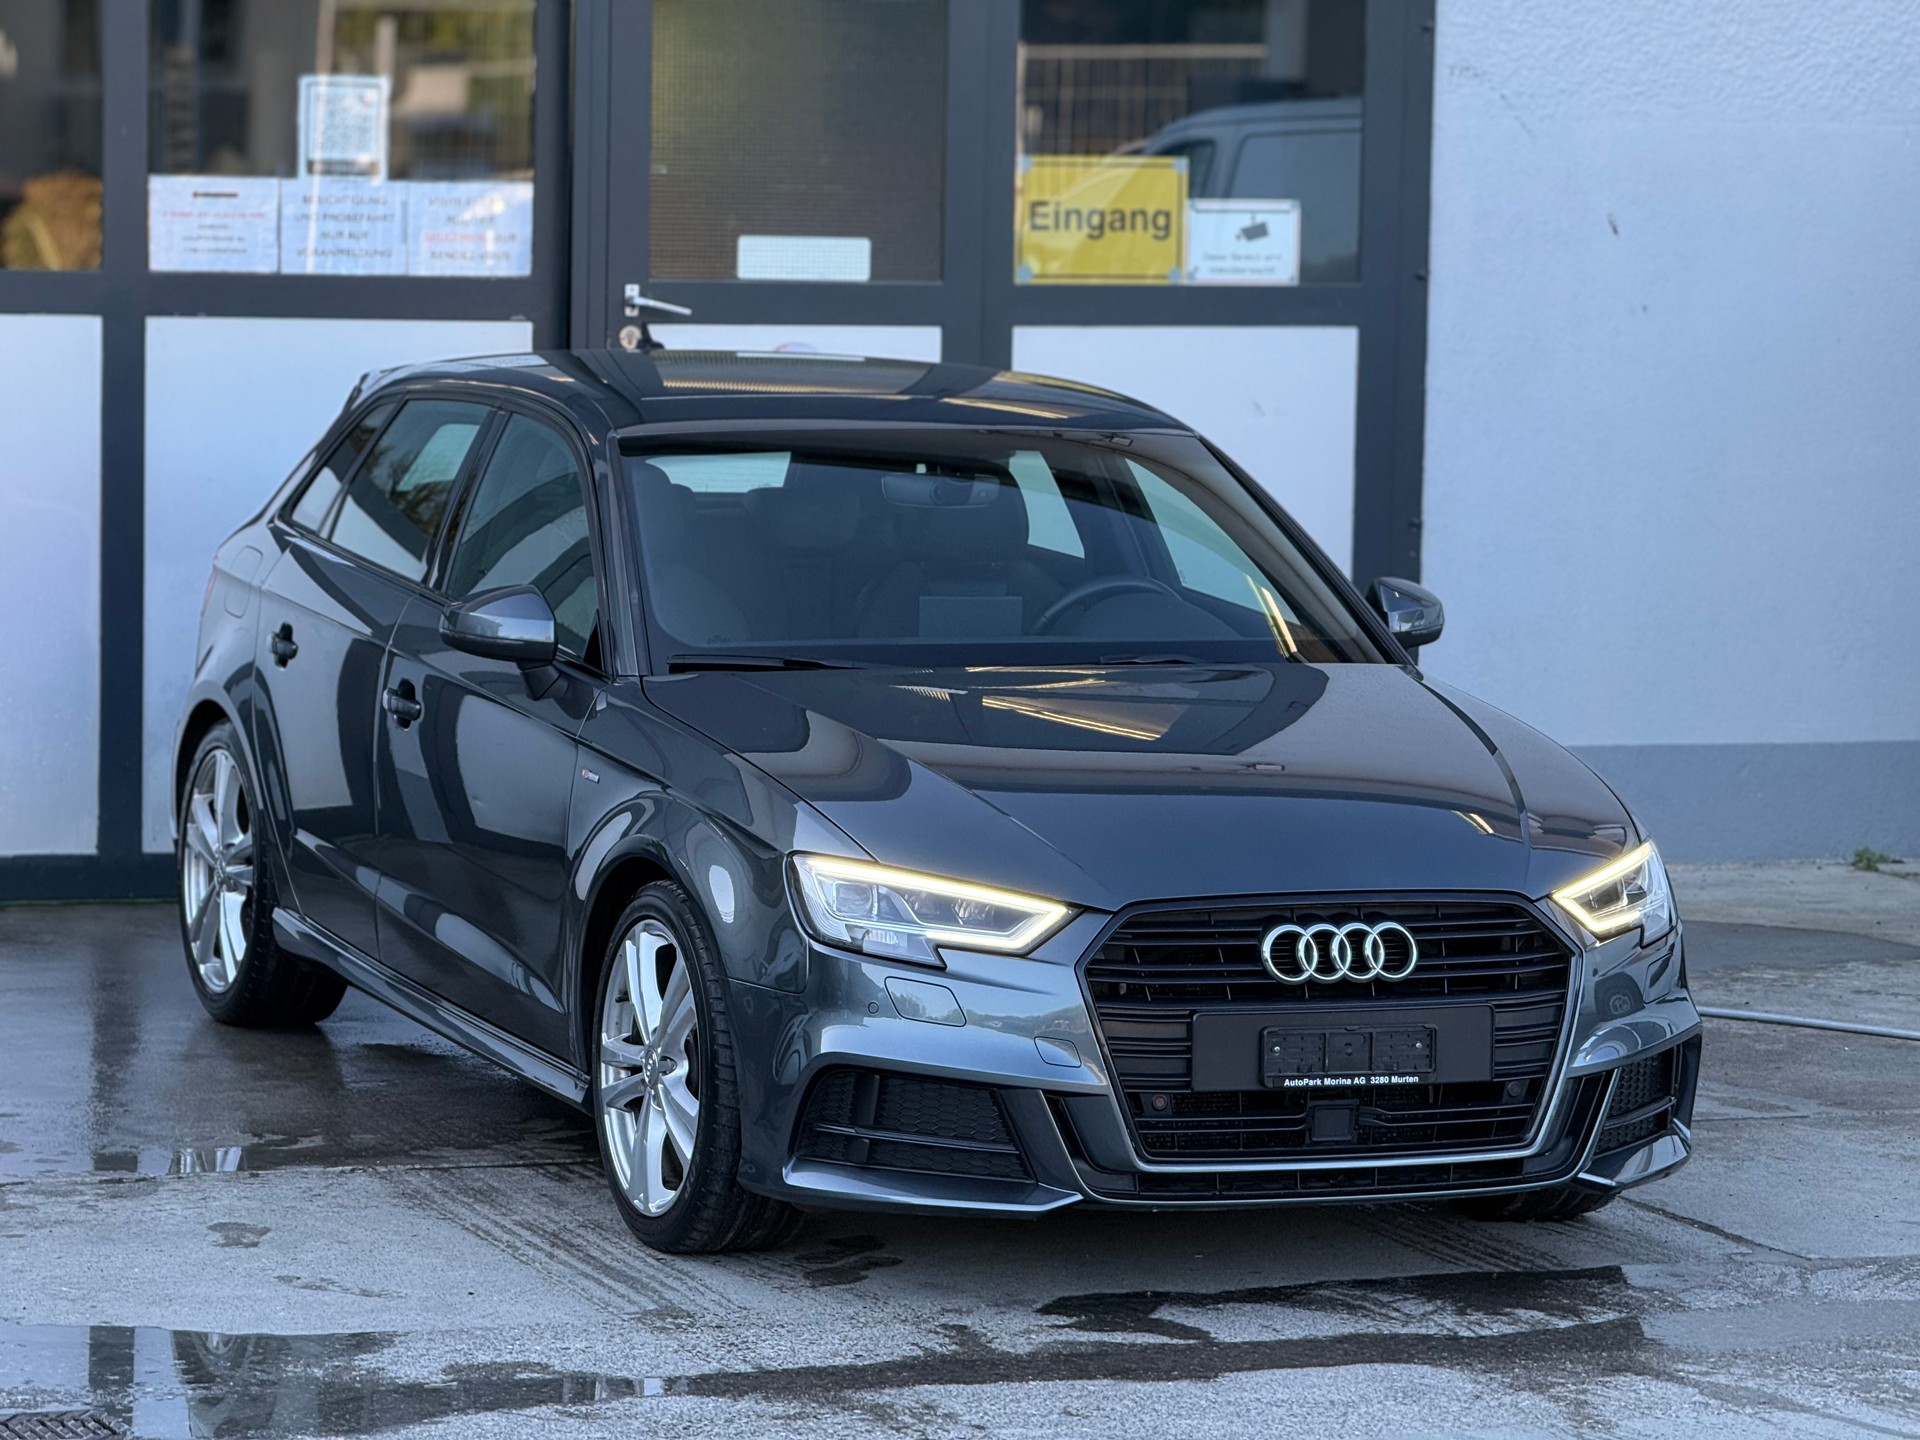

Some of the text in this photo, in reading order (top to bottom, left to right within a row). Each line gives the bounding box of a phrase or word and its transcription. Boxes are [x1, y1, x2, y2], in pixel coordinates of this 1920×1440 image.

[1029, 200, 1172, 240] Eingang
[1284, 1075, 1419, 1087] AutoPark Morina AG 3280 Murten
